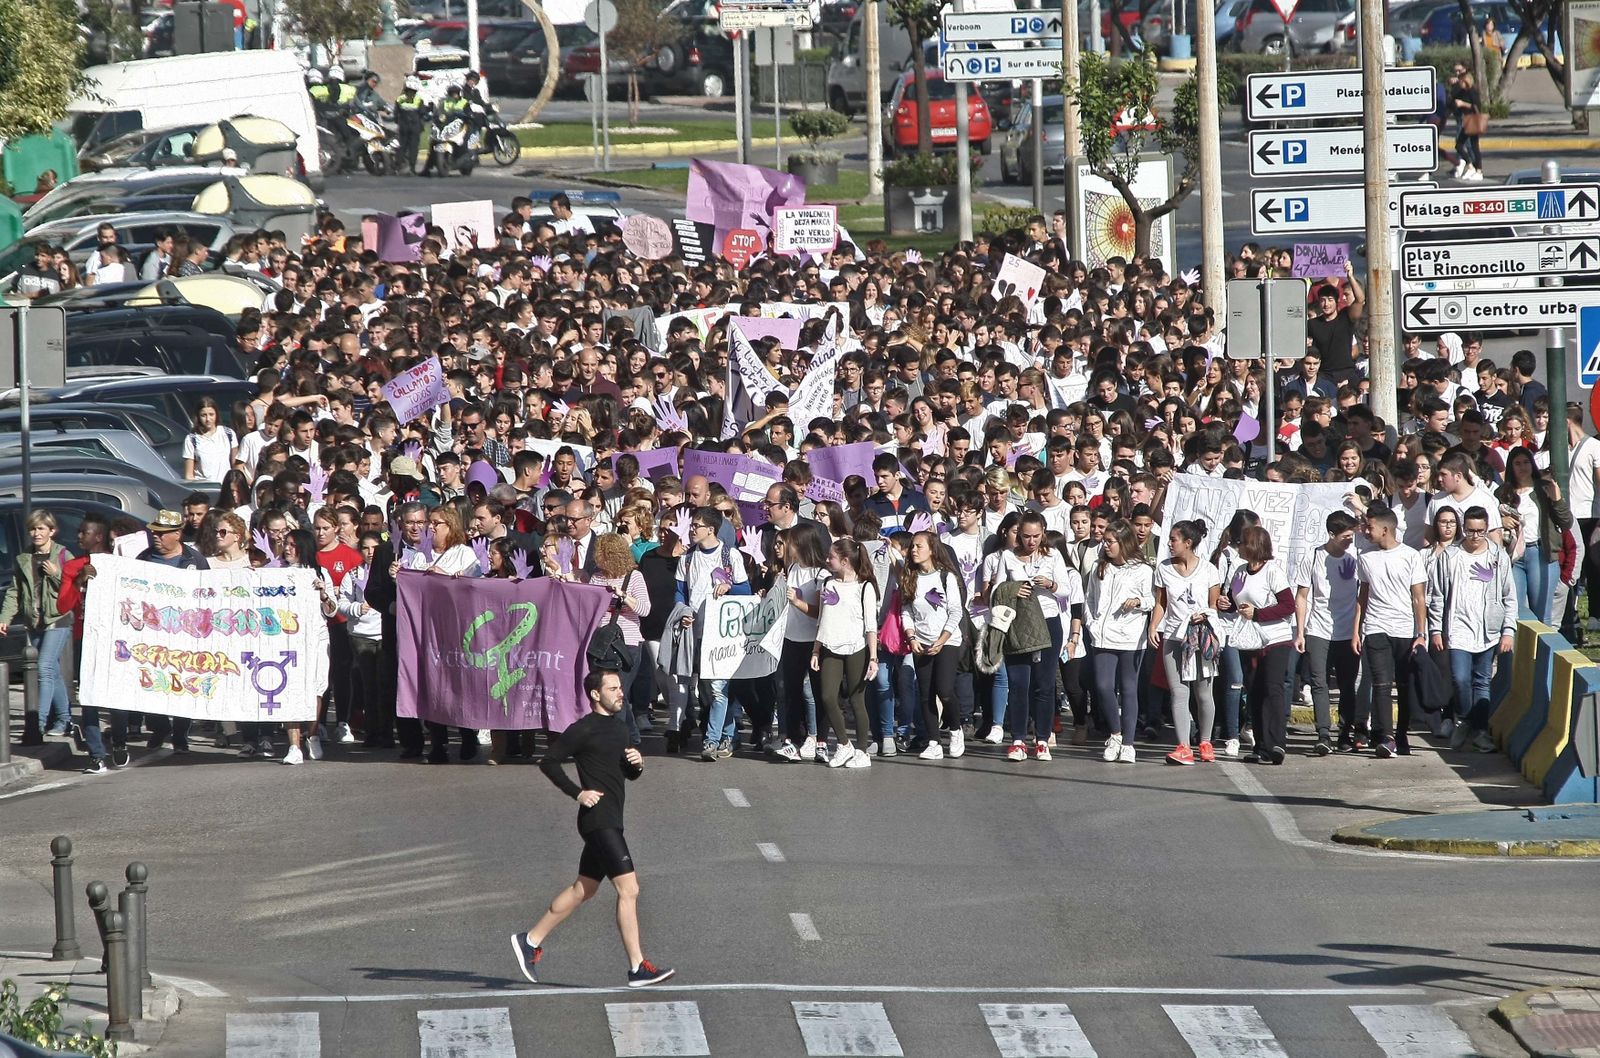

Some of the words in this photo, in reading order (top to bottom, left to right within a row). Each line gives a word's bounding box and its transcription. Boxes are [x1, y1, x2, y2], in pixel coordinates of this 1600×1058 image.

[947, 23, 981, 31] Verboom
[1037, 60, 1063, 69] Europ
[1393, 142, 1432, 154] Tolosa
[785, 211, 796, 219] LA
[798, 210, 831, 218] VIOLENCIA
[1405, 202, 1461, 217] Málaga
[1465, 201, 1504, 213] N-340
[1509, 201, 1535, 212] E-15
[731, 234, 756, 248] STOP
[1295, 244, 1328, 257] DONNA
[1406, 249, 1451, 264] playa
[1008, 256, 1021, 268] 25
[1407, 264, 1424, 277] El
[1433, 259, 1526, 276] Rinconcillo
[1293, 263, 1310, 277] 47
[1472, 302, 1529, 317] centro
[1539, 302, 1577, 315] urba
[406, 360, 435, 379] TODOS
[393, 371, 437, 398] CALLAMOS
[407, 386, 432, 404] TODOS
[1248, 489, 1294, 513] VEZ
[508, 645, 565, 671] Kent
